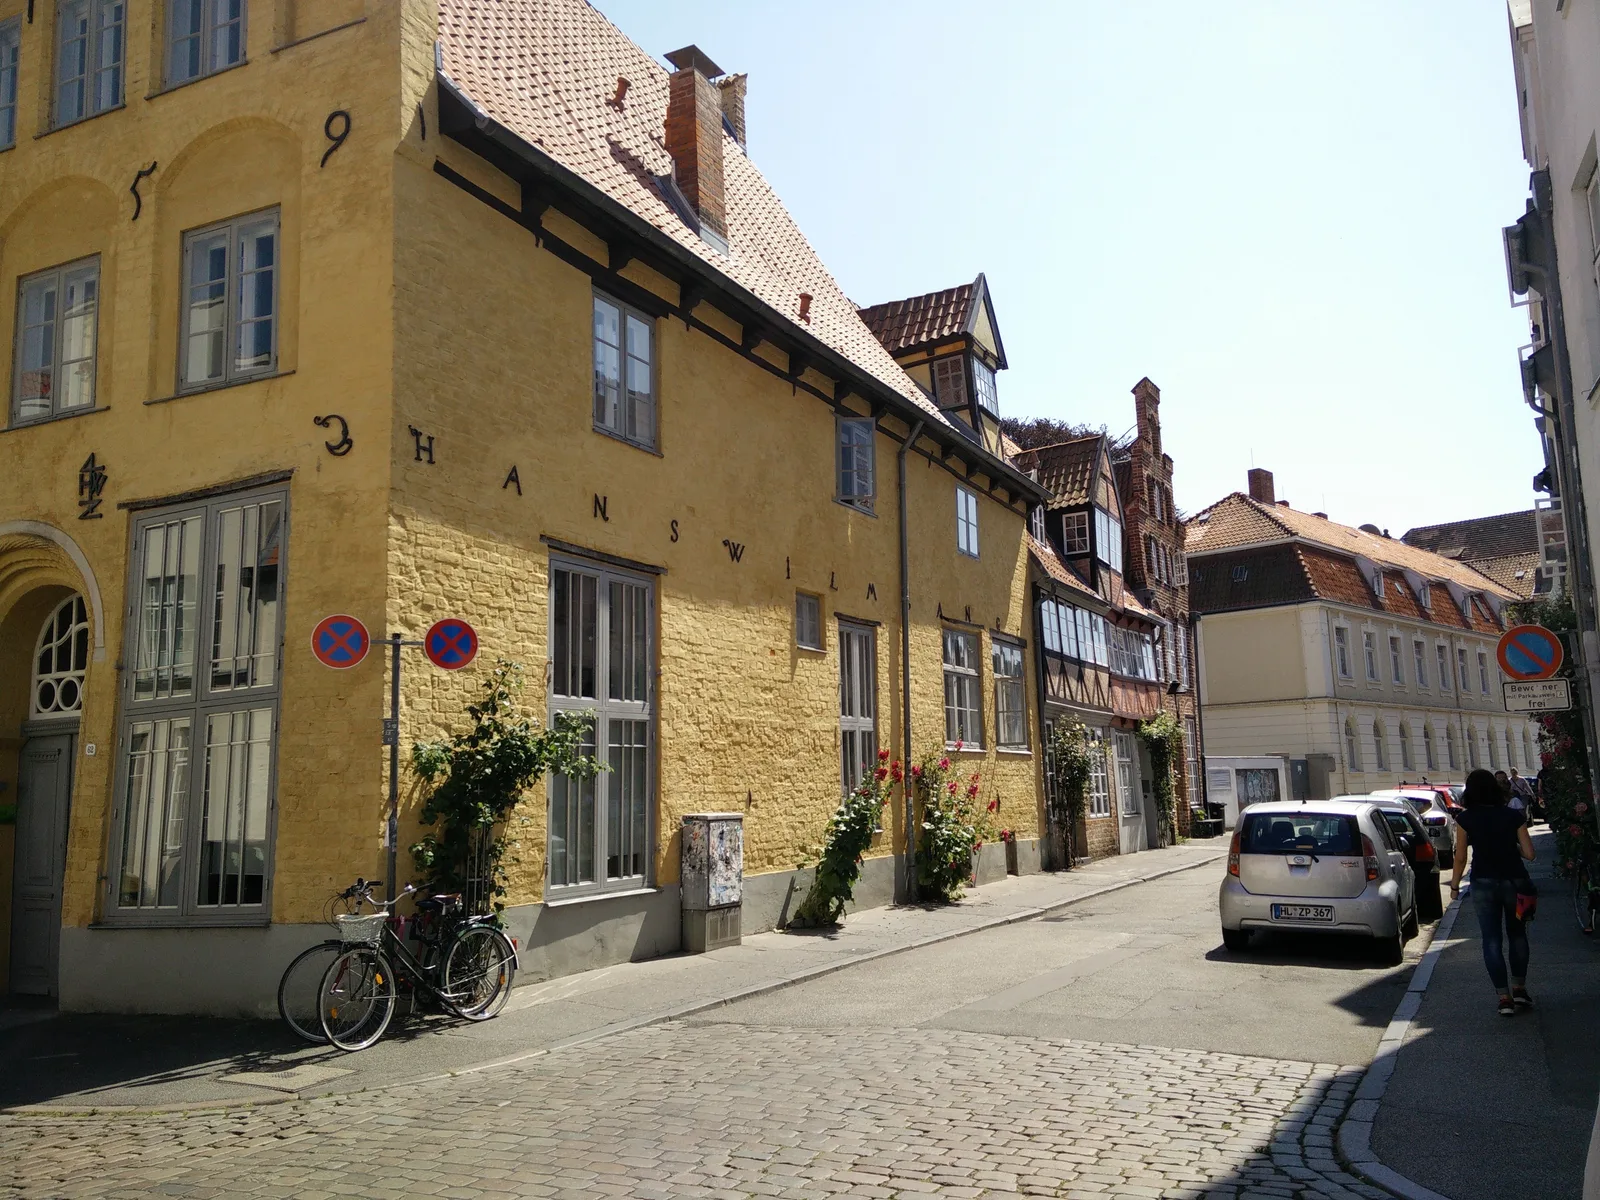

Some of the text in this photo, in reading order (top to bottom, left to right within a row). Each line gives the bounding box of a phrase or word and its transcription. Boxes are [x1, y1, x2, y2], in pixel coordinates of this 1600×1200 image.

[1528, 699, 1546, 708] frei
[1280, 906, 1331, 918] HL ZP 367
